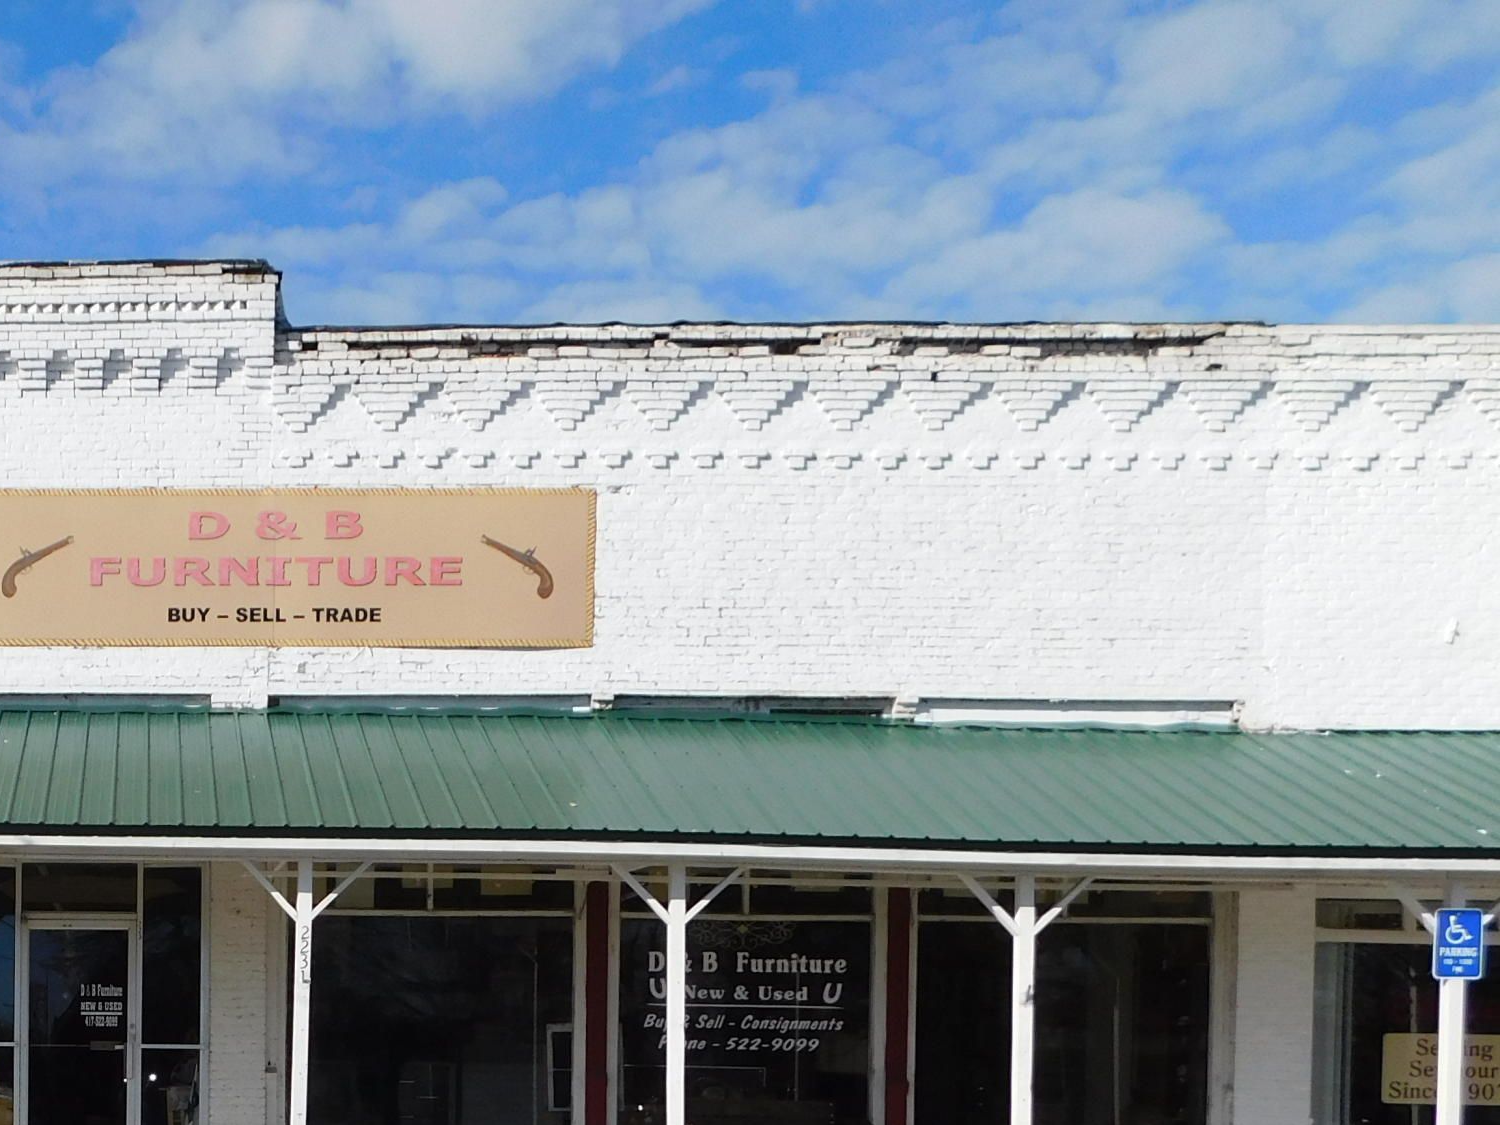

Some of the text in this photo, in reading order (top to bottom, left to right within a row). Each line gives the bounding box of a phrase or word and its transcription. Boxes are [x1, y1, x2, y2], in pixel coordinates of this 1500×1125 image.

[188, 511, 364, 540] D & B
[89, 556, 463, 586] FURNITURE
[167, 607, 210, 622] BUY
[235, 607, 286, 623] SELL
[312, 607, 382, 623] TRADE
[648, 951, 666, 972] D
[702, 951, 719, 972] B
[736, 951, 848, 974] Furniture
[80, 984, 85, 996] D
[684, 984, 808, 1001] New & Used
[695, 1014, 726, 1029] Sell
[740, 1014, 844, 1034] Consignments
[725, 1037, 820, 1052] 522-9099
